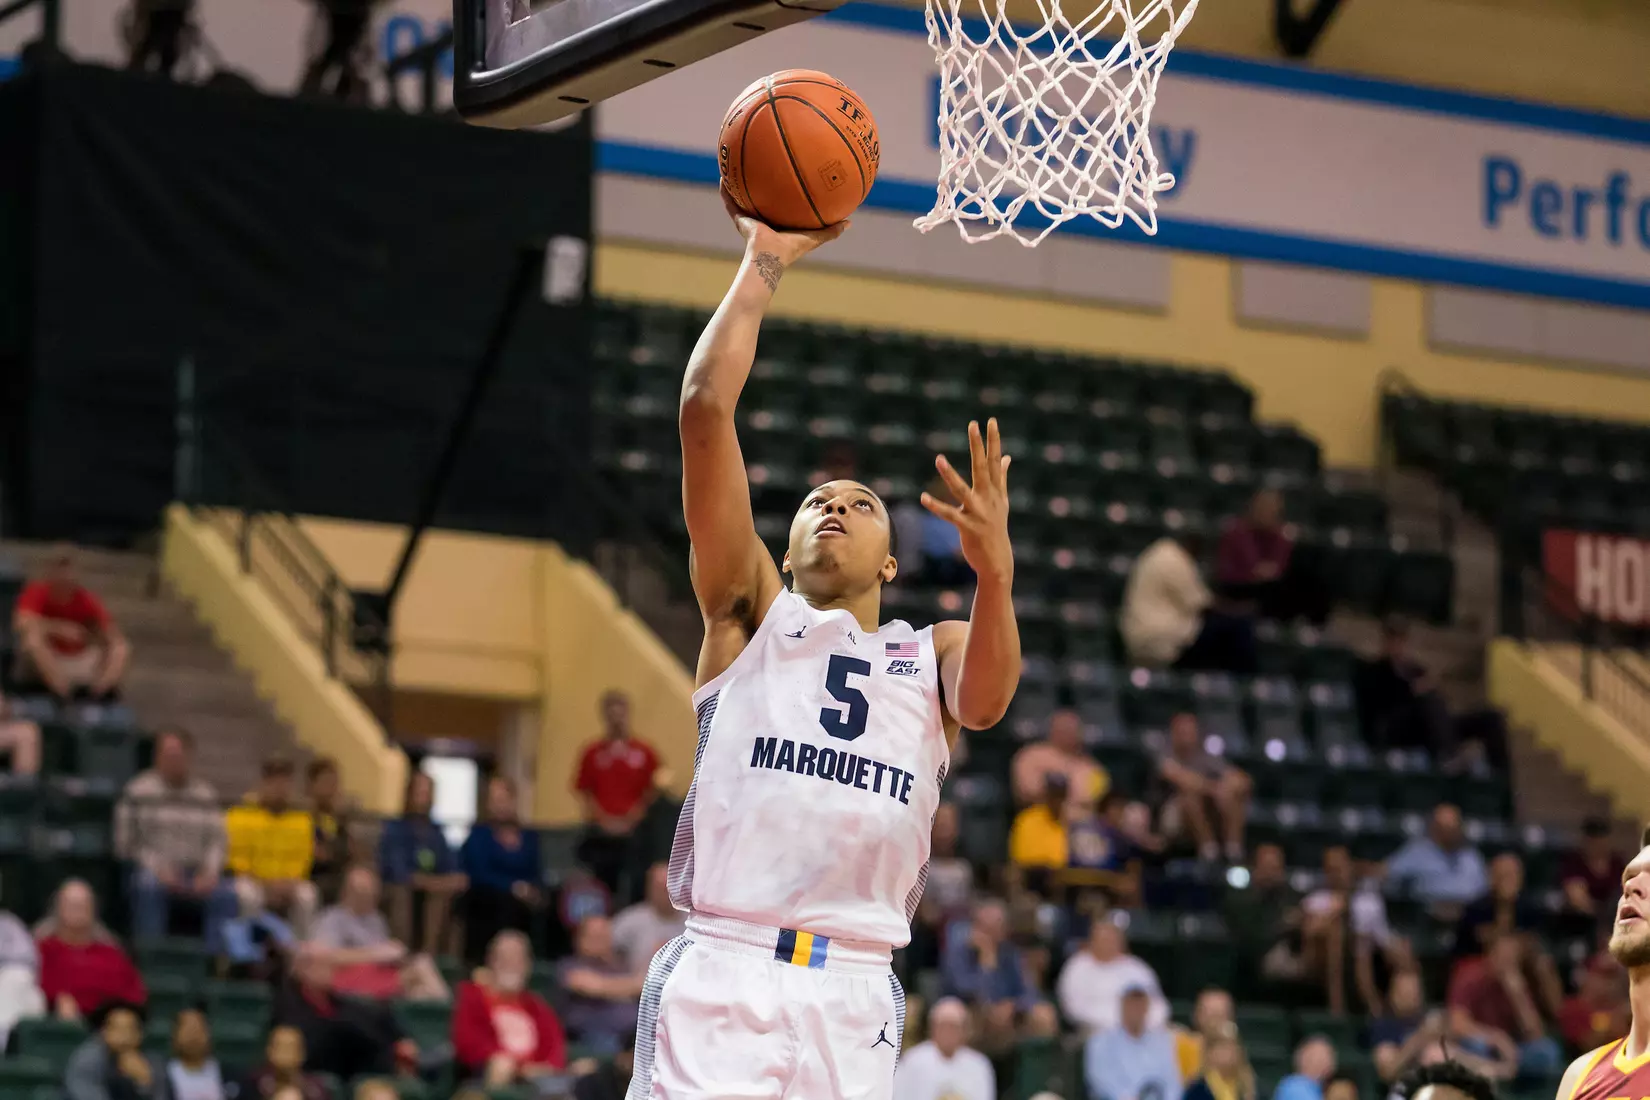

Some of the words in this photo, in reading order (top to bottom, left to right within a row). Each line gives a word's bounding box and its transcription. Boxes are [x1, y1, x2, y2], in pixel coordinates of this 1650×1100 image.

[1576, 533, 1650, 622] HO
[819, 654, 871, 741] 5
[886, 666, 921, 675] EAST
[890, 660, 915, 668] BIG
[750, 737, 915, 805] MARQUETTE
